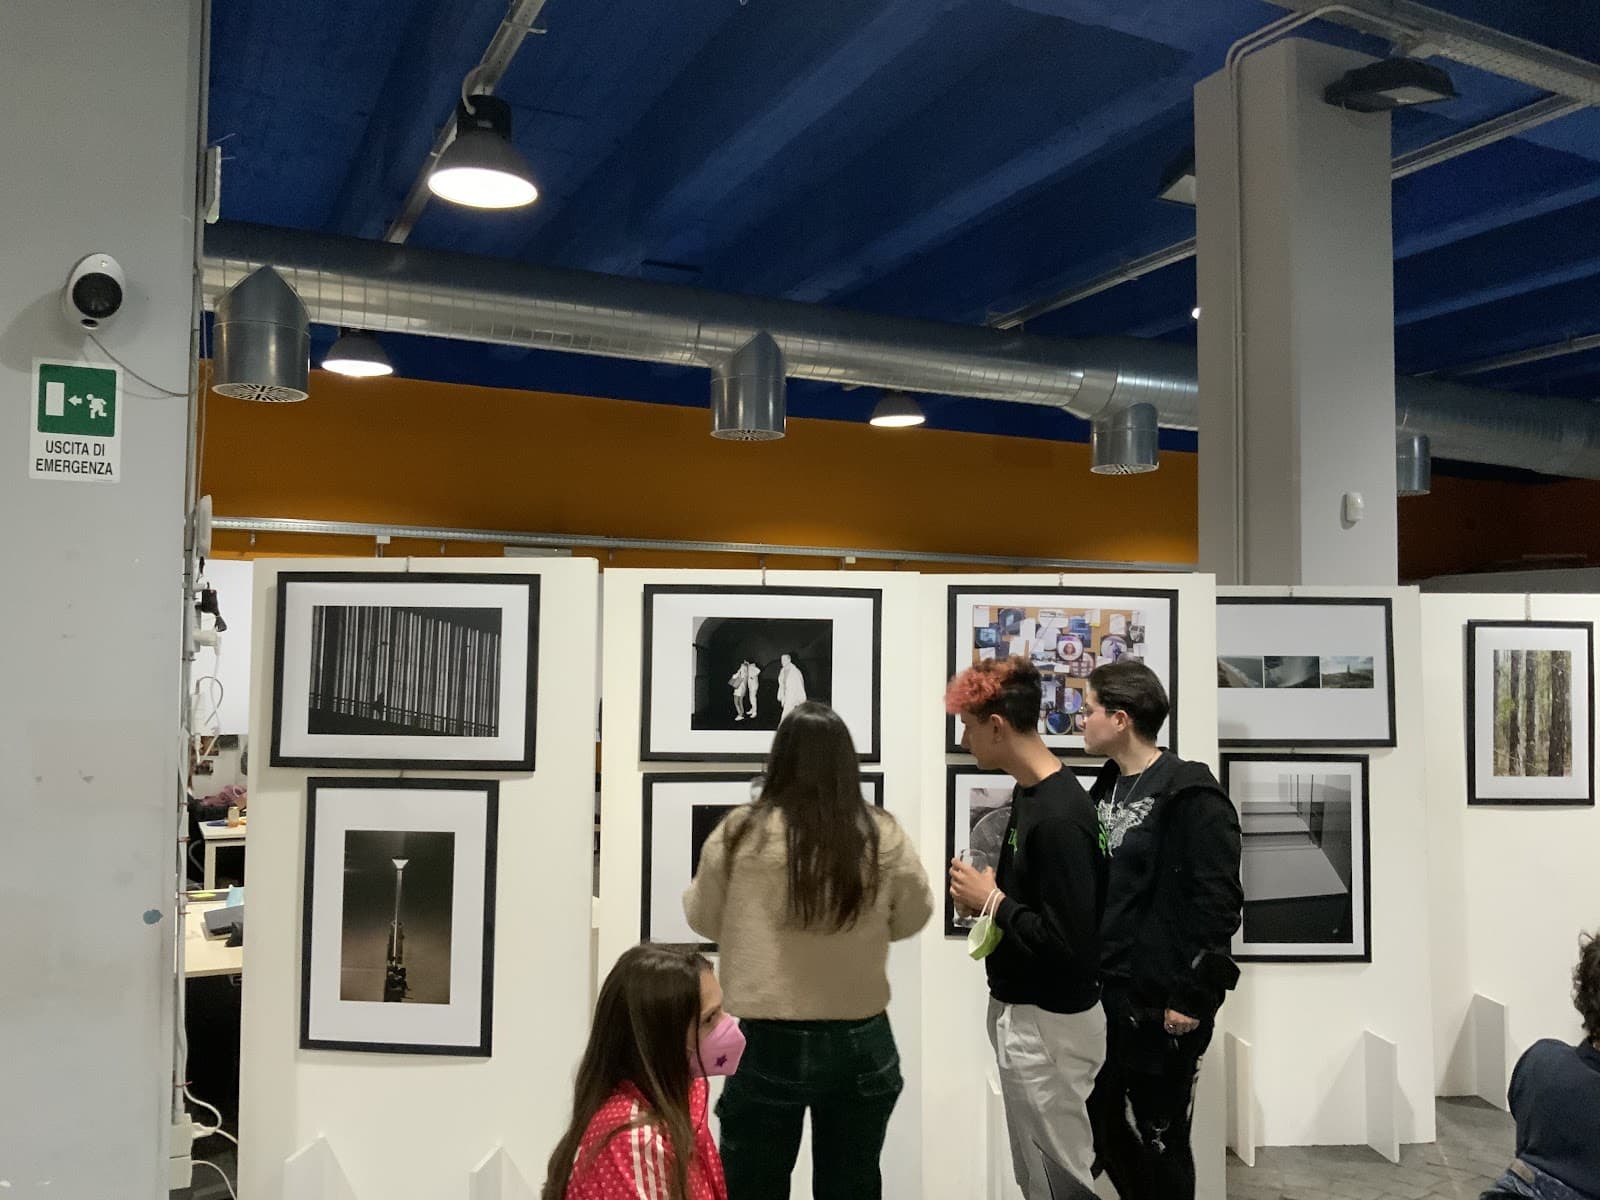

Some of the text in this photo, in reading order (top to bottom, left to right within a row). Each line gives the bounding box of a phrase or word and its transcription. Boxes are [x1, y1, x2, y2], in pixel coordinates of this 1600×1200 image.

[45, 440, 105, 456] USCITA DI
[35, 458, 113, 475] EMERGENZA
